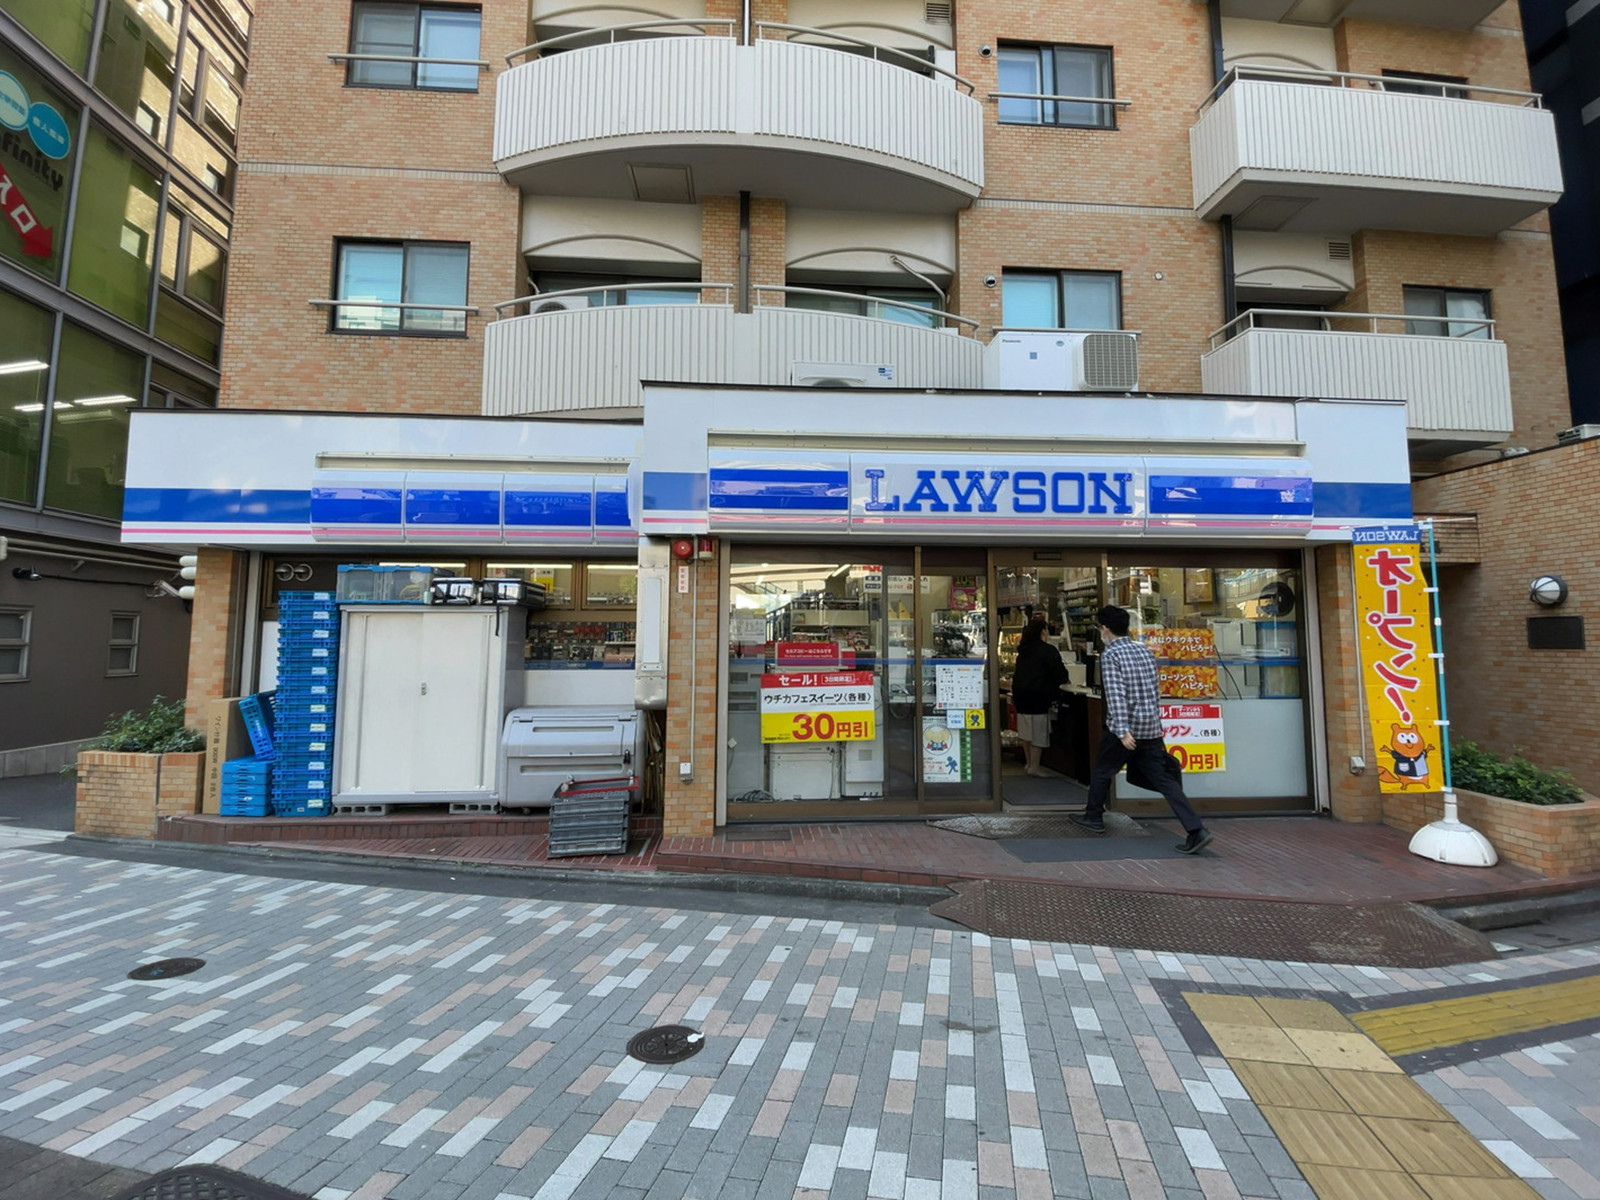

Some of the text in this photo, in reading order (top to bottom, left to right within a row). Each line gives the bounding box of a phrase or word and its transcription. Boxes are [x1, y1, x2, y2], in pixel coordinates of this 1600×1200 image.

[0, 131, 64, 191] finity
[865, 468, 1133, 515] LAWSON
[779, 674, 818, 687] セール!
[792, 713, 868, 740] 30円引
